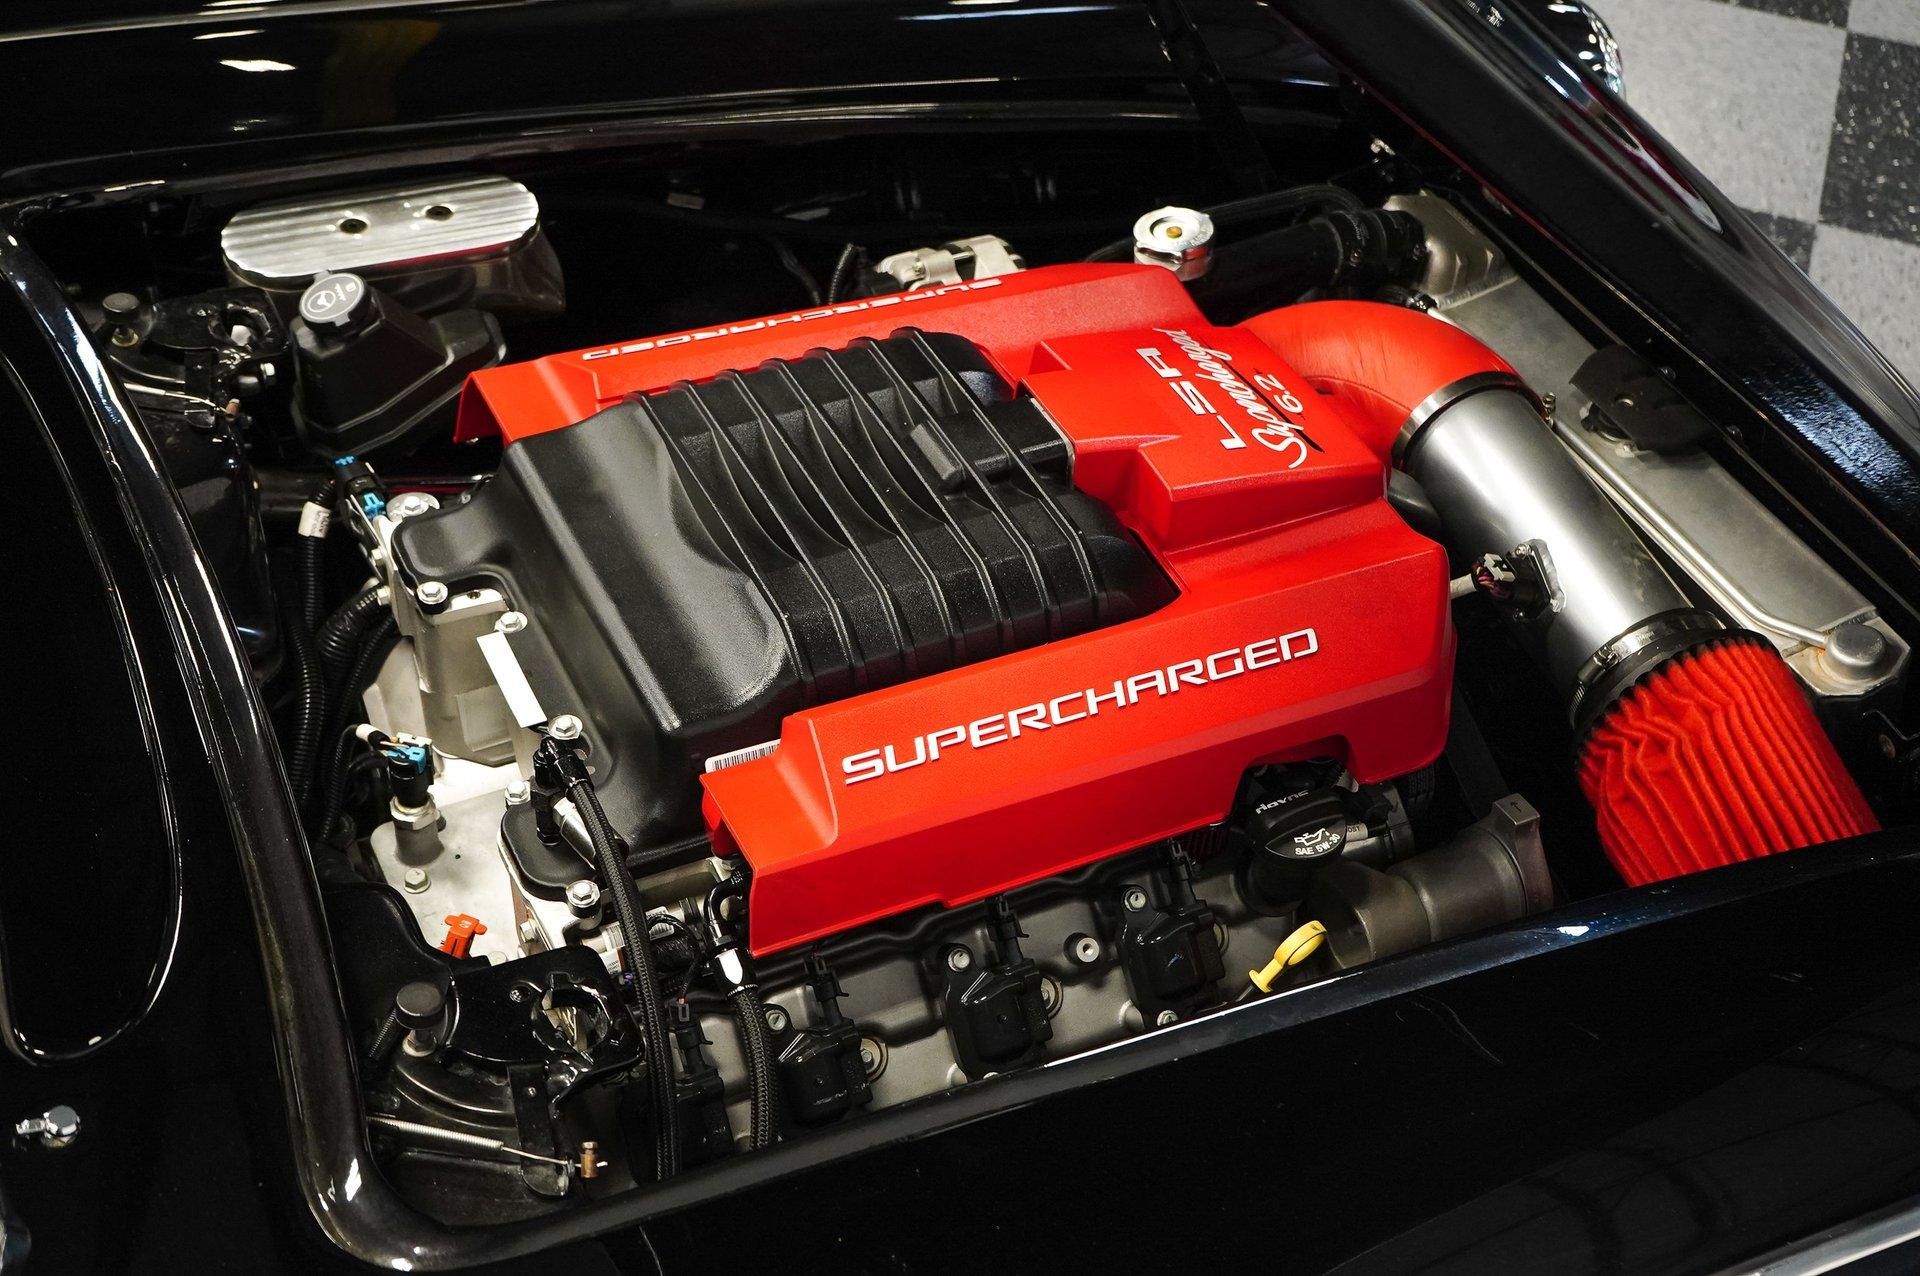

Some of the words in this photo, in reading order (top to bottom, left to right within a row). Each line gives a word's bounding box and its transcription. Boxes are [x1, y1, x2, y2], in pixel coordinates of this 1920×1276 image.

[581, 277, 1003, 361] SUPERCHARGED
[1135, 347, 1247, 450] LSA
[1152, 327, 1308, 469] Supercharged
[1253, 373, 1304, 414] 6.2
[841, 627, 1319, 785] SUPERCHARGED
[1295, 846, 1315, 856] SAE
[1315, 833, 1341, 853] 5W-30
